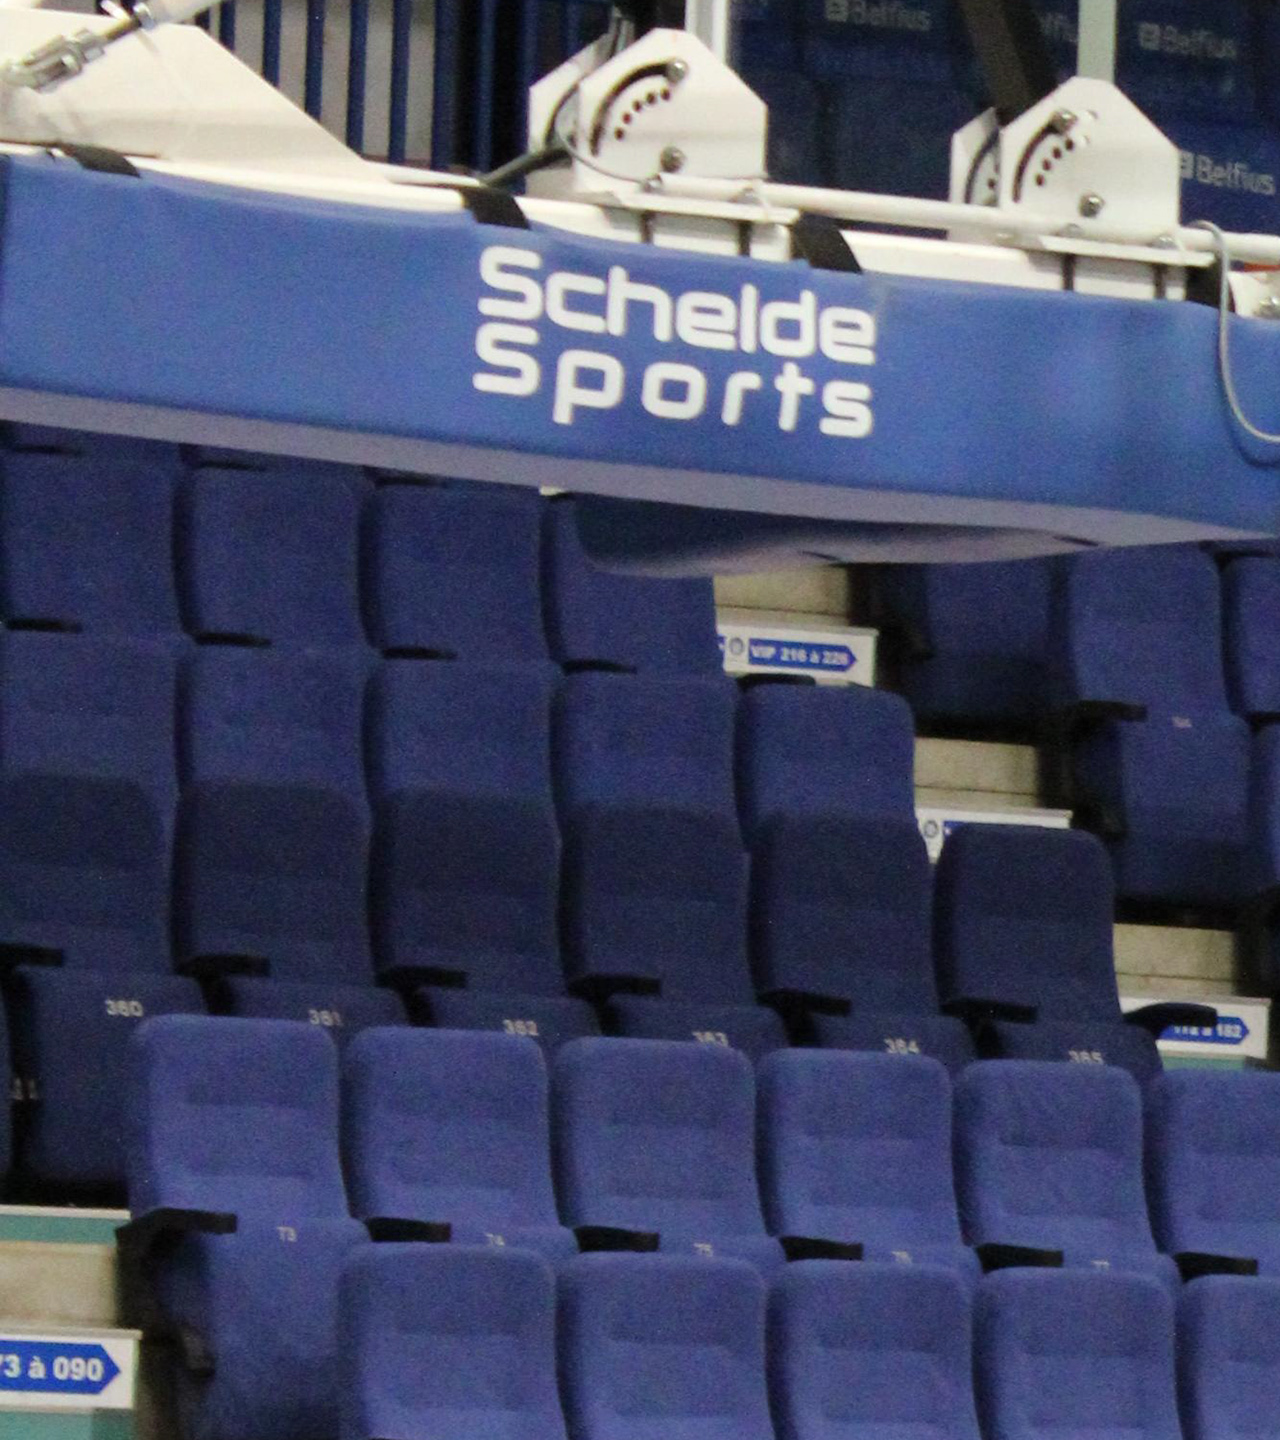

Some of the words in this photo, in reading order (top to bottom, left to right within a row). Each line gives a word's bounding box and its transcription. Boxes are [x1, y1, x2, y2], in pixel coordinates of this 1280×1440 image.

[1196, 155, 1276, 195] Belfius
[477, 245, 878, 364] Schelde
[474, 320, 874, 438] Sports
[752, 644, 776, 659] VIP
[28, 1356, 46, 1379] à
[52, 1356, 104, 1382] 090
